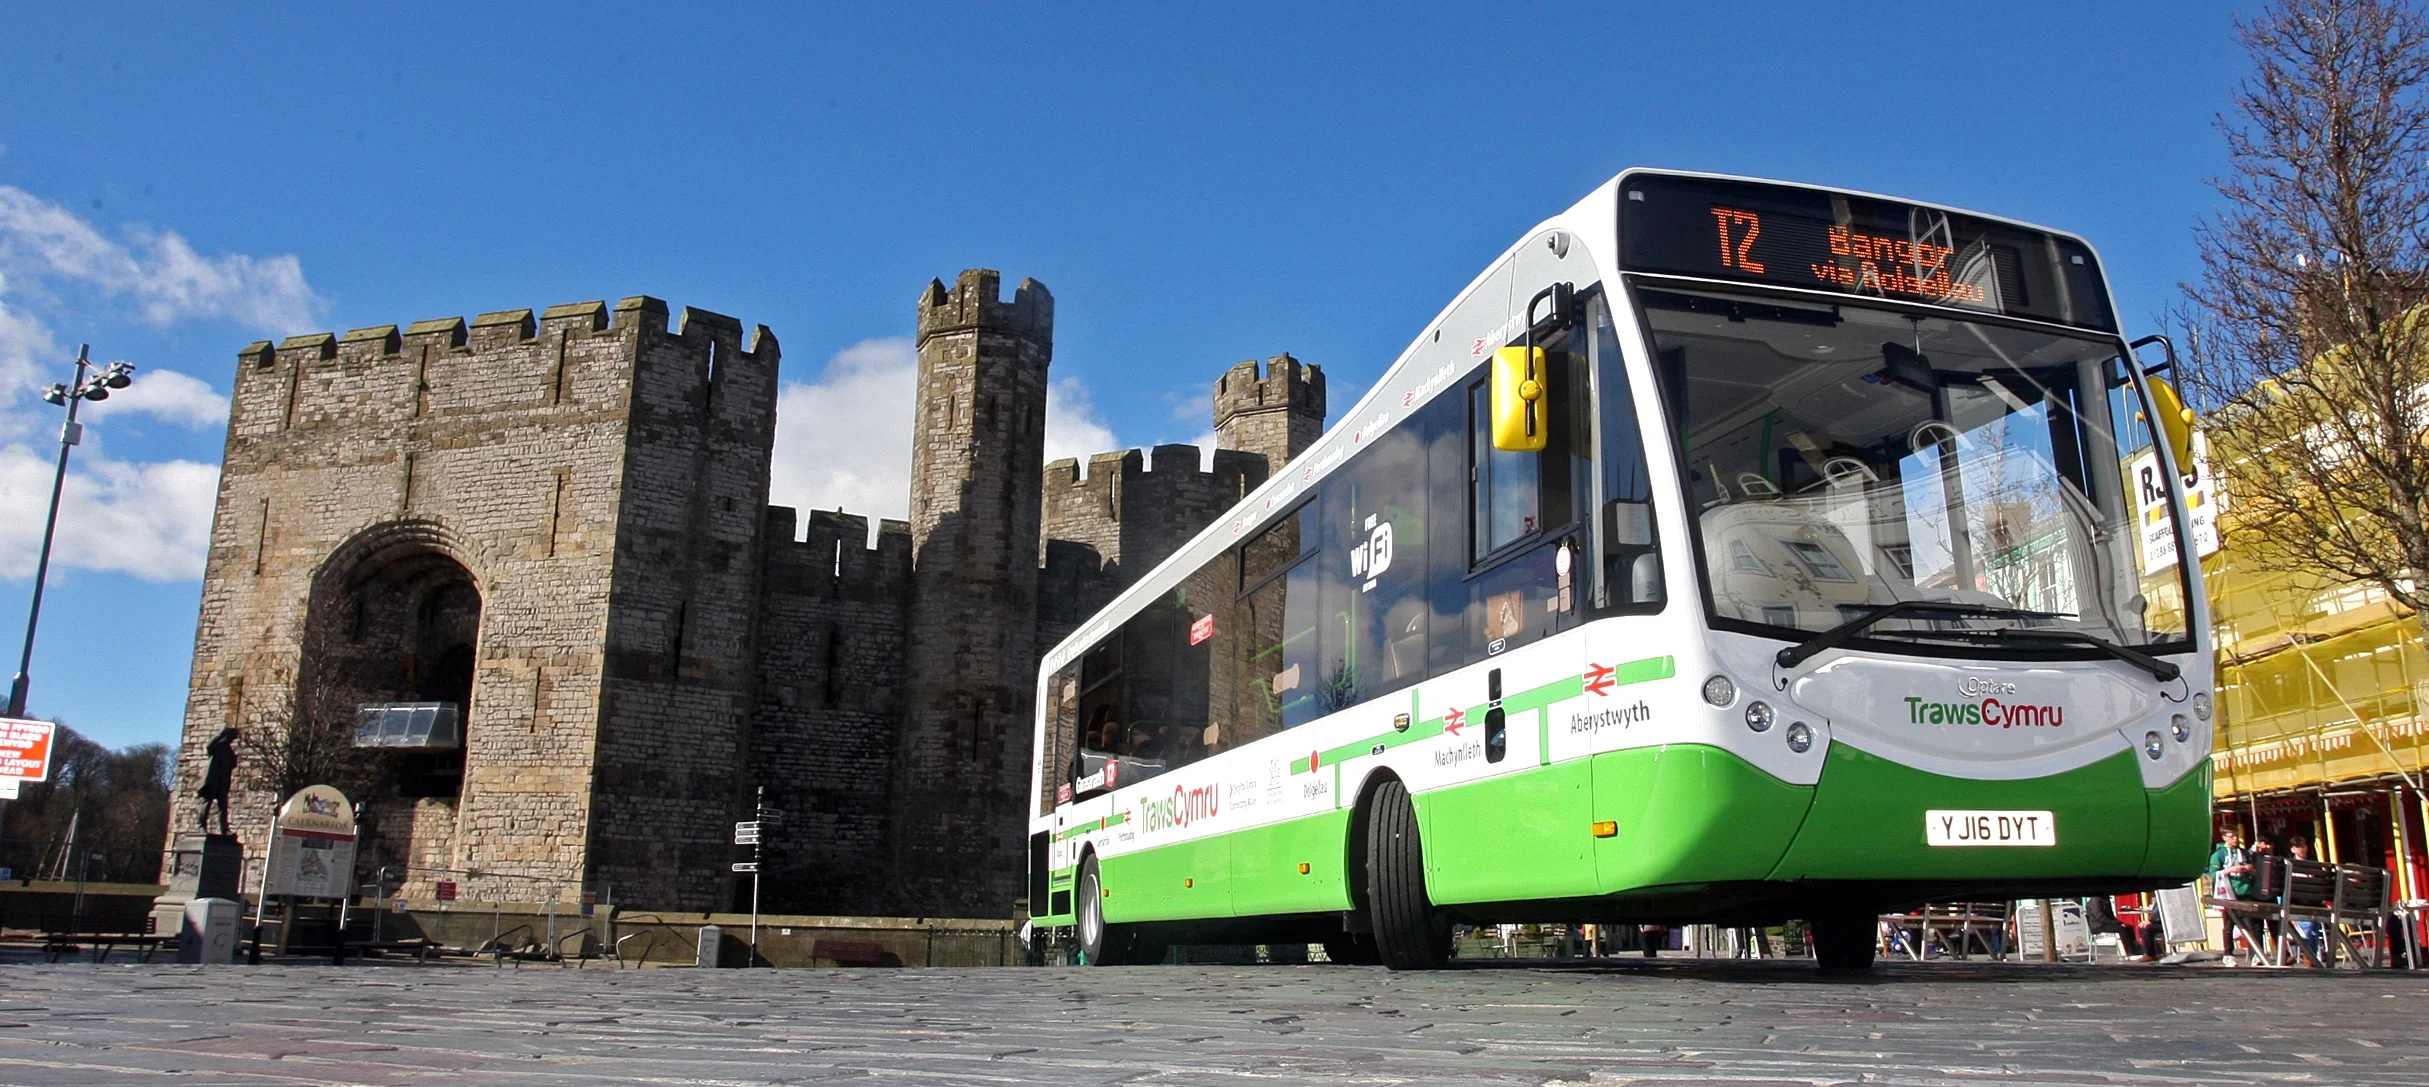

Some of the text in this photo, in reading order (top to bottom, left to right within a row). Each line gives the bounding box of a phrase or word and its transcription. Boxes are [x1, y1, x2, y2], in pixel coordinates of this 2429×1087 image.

[1709, 207, 1955, 275] T2 Bangor
[1811, 259, 1854, 286] via
[1571, 700, 1651, 735] Aberystwyth
[1903, 697, 2063, 729] TrawsCymru
[1434, 740, 1481, 768] Machynlleth
[288, 815, 349, 831] CAERNARFON
[1140, 782, 1218, 834] TrawsCymru
[1941, 816, 2038, 841] YJ16 DYT
